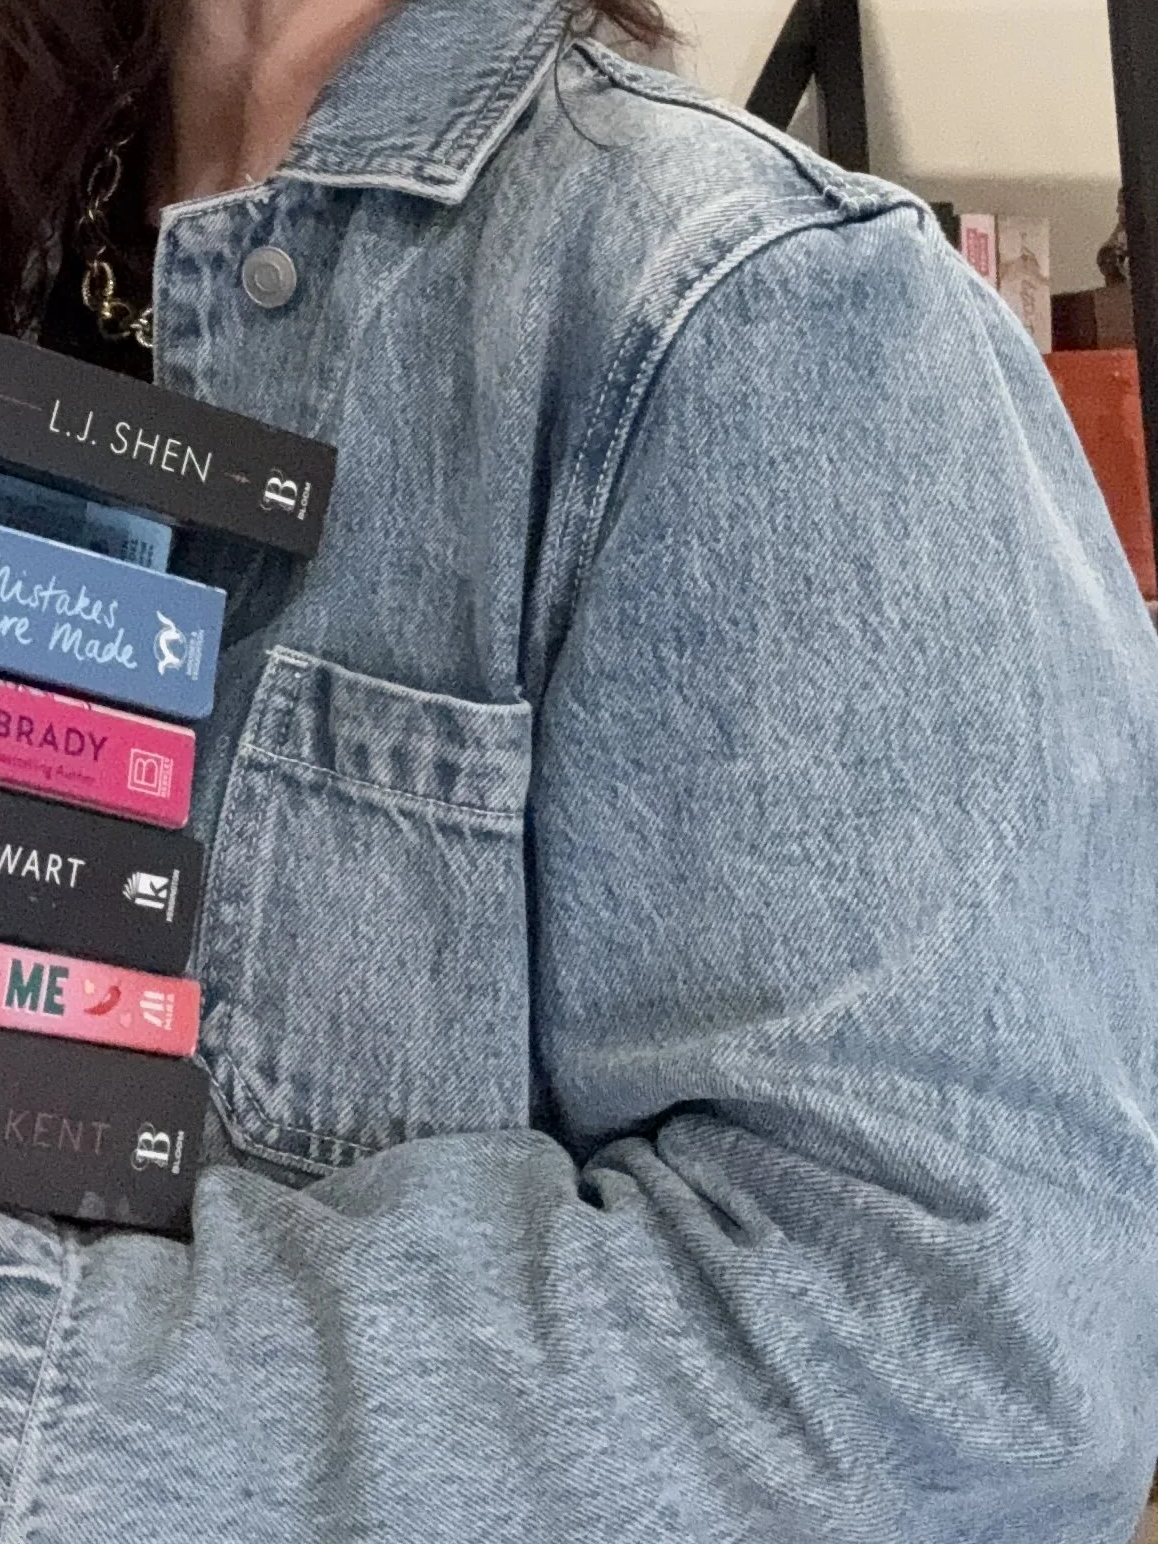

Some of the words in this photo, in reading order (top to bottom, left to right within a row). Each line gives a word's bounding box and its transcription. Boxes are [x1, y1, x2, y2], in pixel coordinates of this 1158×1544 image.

[49, 399, 97, 446] L.J.
[110, 422, 213, 483] SHEN
[48, 621, 138, 669] Made
[2, 958, 70, 1017] ME
[4, 1108, 112, 1155] KENT
